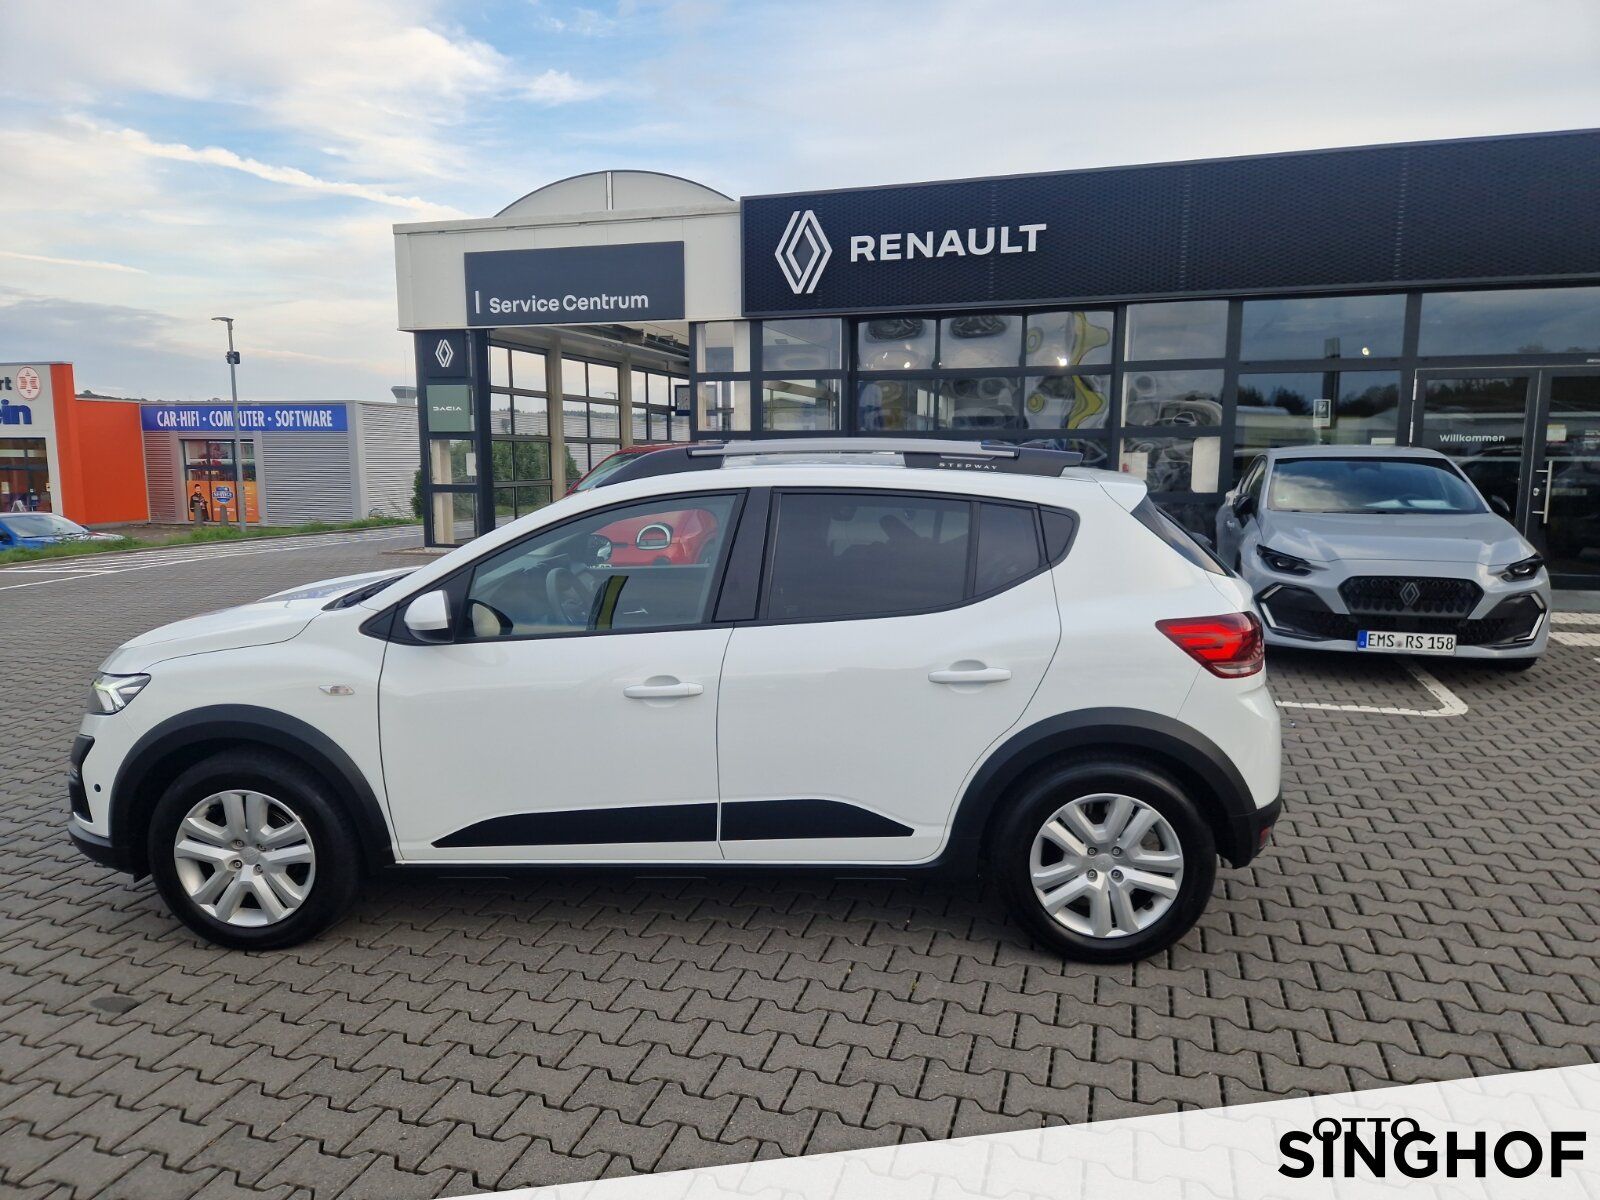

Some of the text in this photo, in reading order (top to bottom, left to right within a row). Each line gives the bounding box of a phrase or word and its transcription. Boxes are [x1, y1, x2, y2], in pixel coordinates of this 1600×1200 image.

[850, 223, 1047, 263] RENAULT
[489, 293, 649, 314] Service Centrum
[0, 399, 32, 425] in
[157, 410, 333, 427] CAR-HIFI COMUTER SOFTWARE
[1439, 433, 1506, 442] Willkommen
[1368, 633, 1395, 648] EMS
[1406, 635, 1424, 649] RS
[1428, 636, 1454, 650] 158
